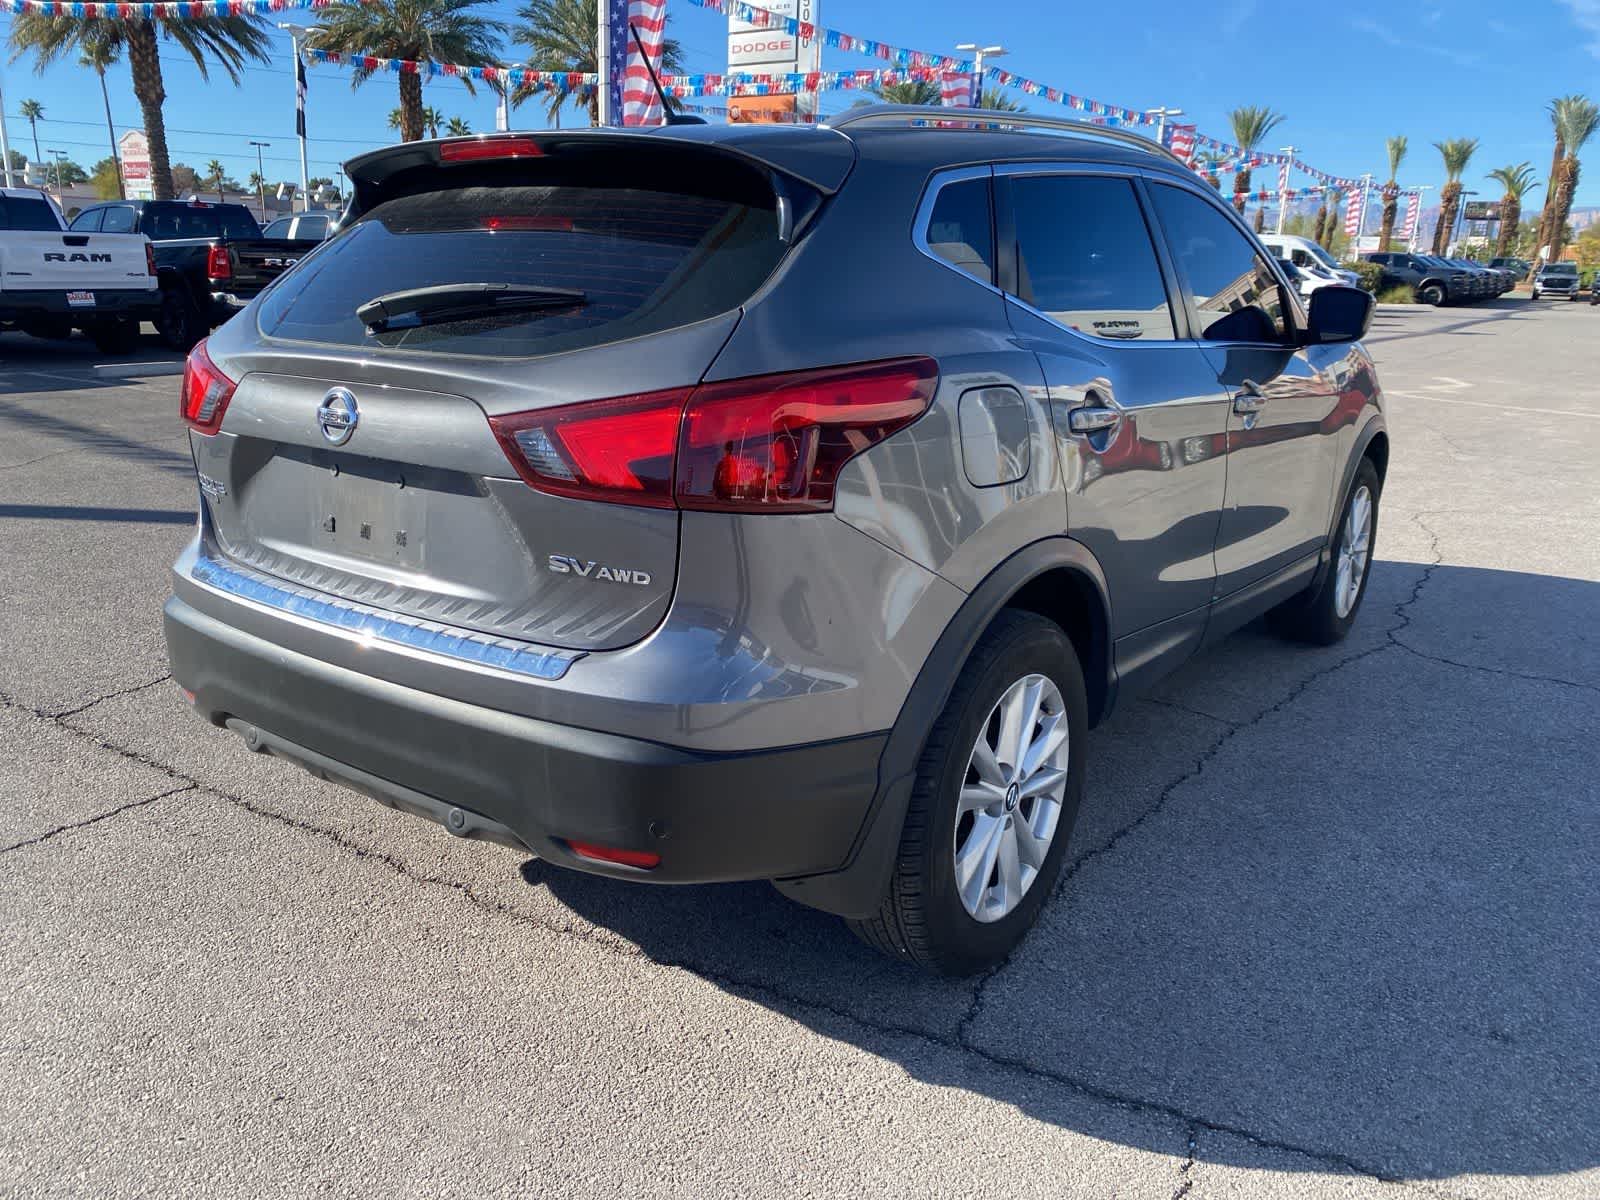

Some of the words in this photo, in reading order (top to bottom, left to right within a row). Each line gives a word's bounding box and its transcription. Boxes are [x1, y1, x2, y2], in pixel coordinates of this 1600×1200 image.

[732, 40, 792, 54] DODGE
[43, 253, 112, 262] RAM
[264, 258, 297, 266] RA
[548, 554, 596, 577] SV
[596, 567, 651, 585] AWD
